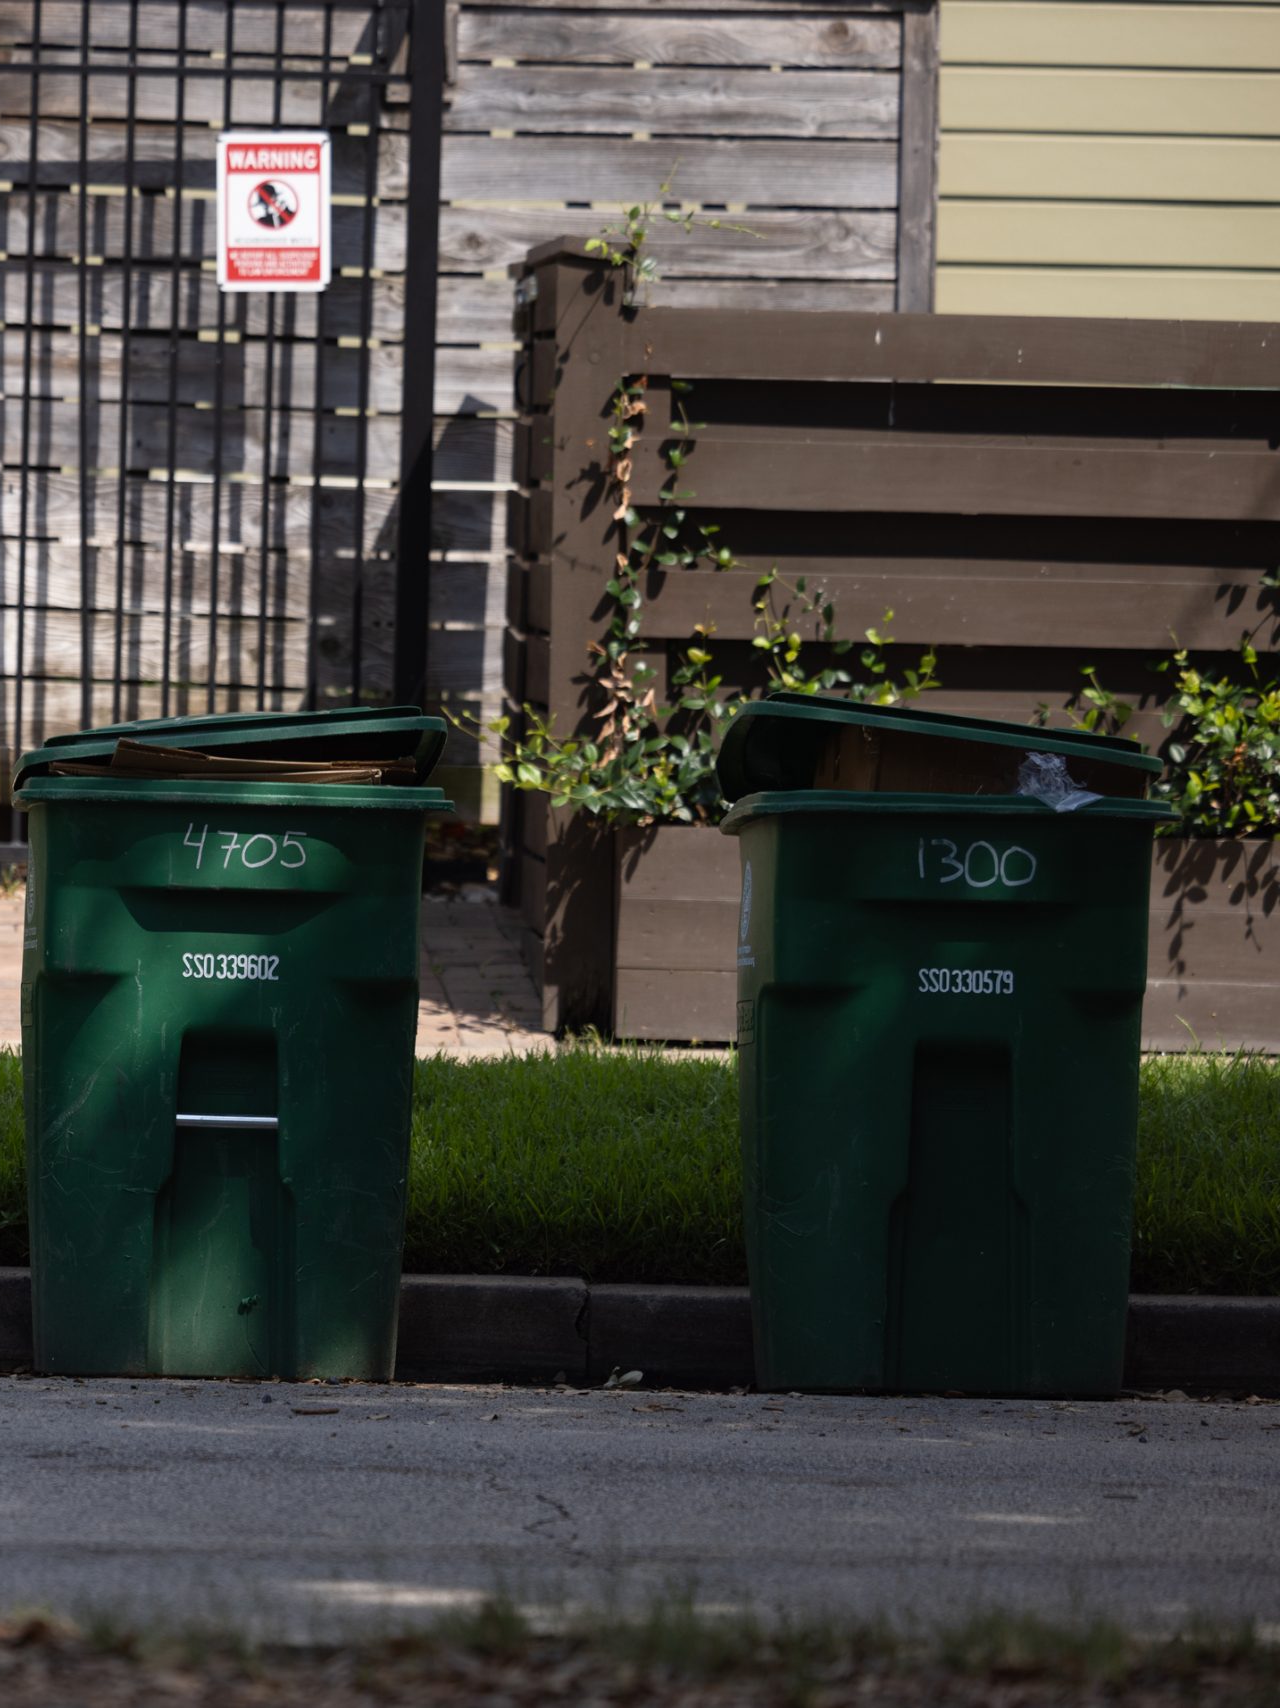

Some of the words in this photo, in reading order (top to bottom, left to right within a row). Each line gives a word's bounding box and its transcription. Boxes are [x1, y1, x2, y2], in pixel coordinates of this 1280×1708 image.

[229, 150, 318, 170] WARNING
[183, 822, 308, 869] 4705
[919, 838, 1037, 888] 1300
